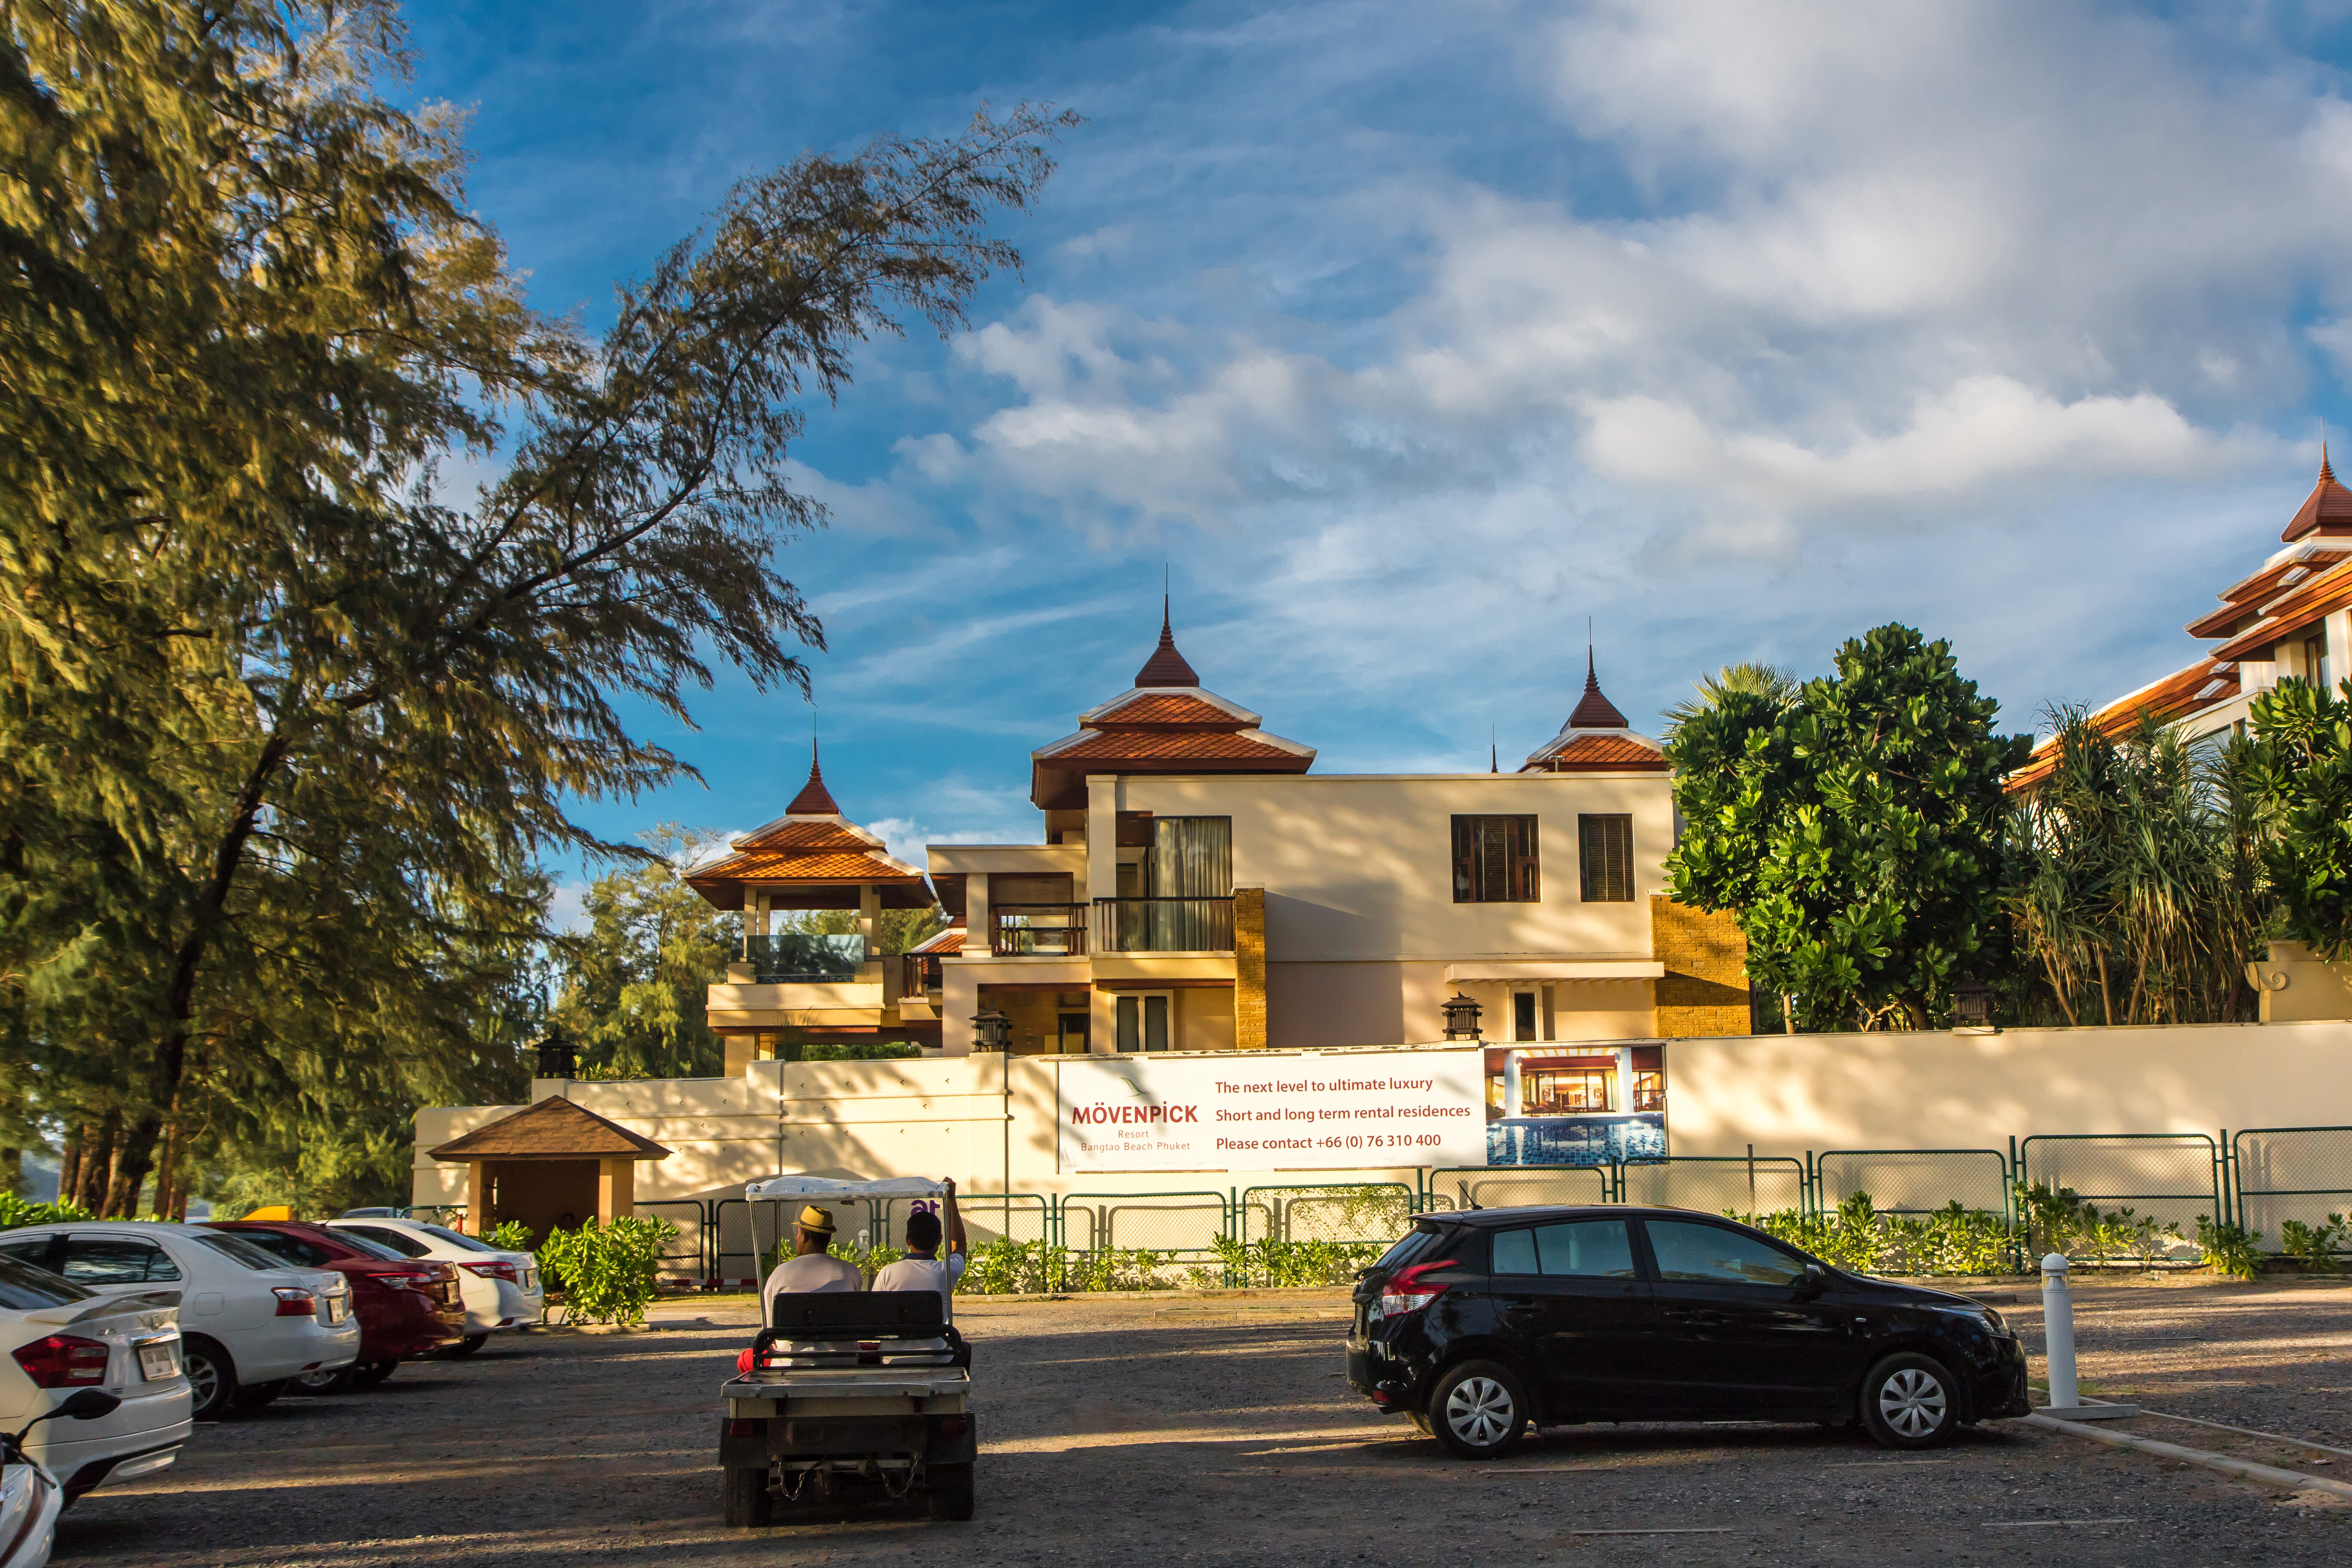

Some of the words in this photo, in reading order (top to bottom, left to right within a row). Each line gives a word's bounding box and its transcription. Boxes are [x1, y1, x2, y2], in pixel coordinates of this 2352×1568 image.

[1215, 1081, 1240, 1093] The
[1243, 1082, 1273, 1093] next
[1277, 1079, 1308, 1092] level
[1311, 1081, 1325, 1092] to
[1329, 1078, 1386, 1091] ultimate
[1390, 1077, 1433, 1092] luxury
[1216, 1109, 1253, 1121] Short
[1256, 1108, 1281, 1121] and
[1285, 1108, 1314, 1123] long
[1318, 1109, 1350, 1119] term
[1354, 1105, 1394, 1118] rental
[1398, 1105, 1470, 1118] residences
[1118, 1130, 1149, 1138] Resort
[1216, 1137, 1259, 1149] Please
[1262, 1137, 1313, 1149] contact
[1316, 1136, 1342, 1148] +66
[1346, 1135, 1363, 1149] (0)
[1367, 1135, 1383, 1147] 76
[1387, 1135, 1412, 1146] 310
[1415, 1134, 1441, 1146] 400
[1081, 1142, 1120, 1153] Bangtao
[1157, 1142, 1190, 1150] Phuket
